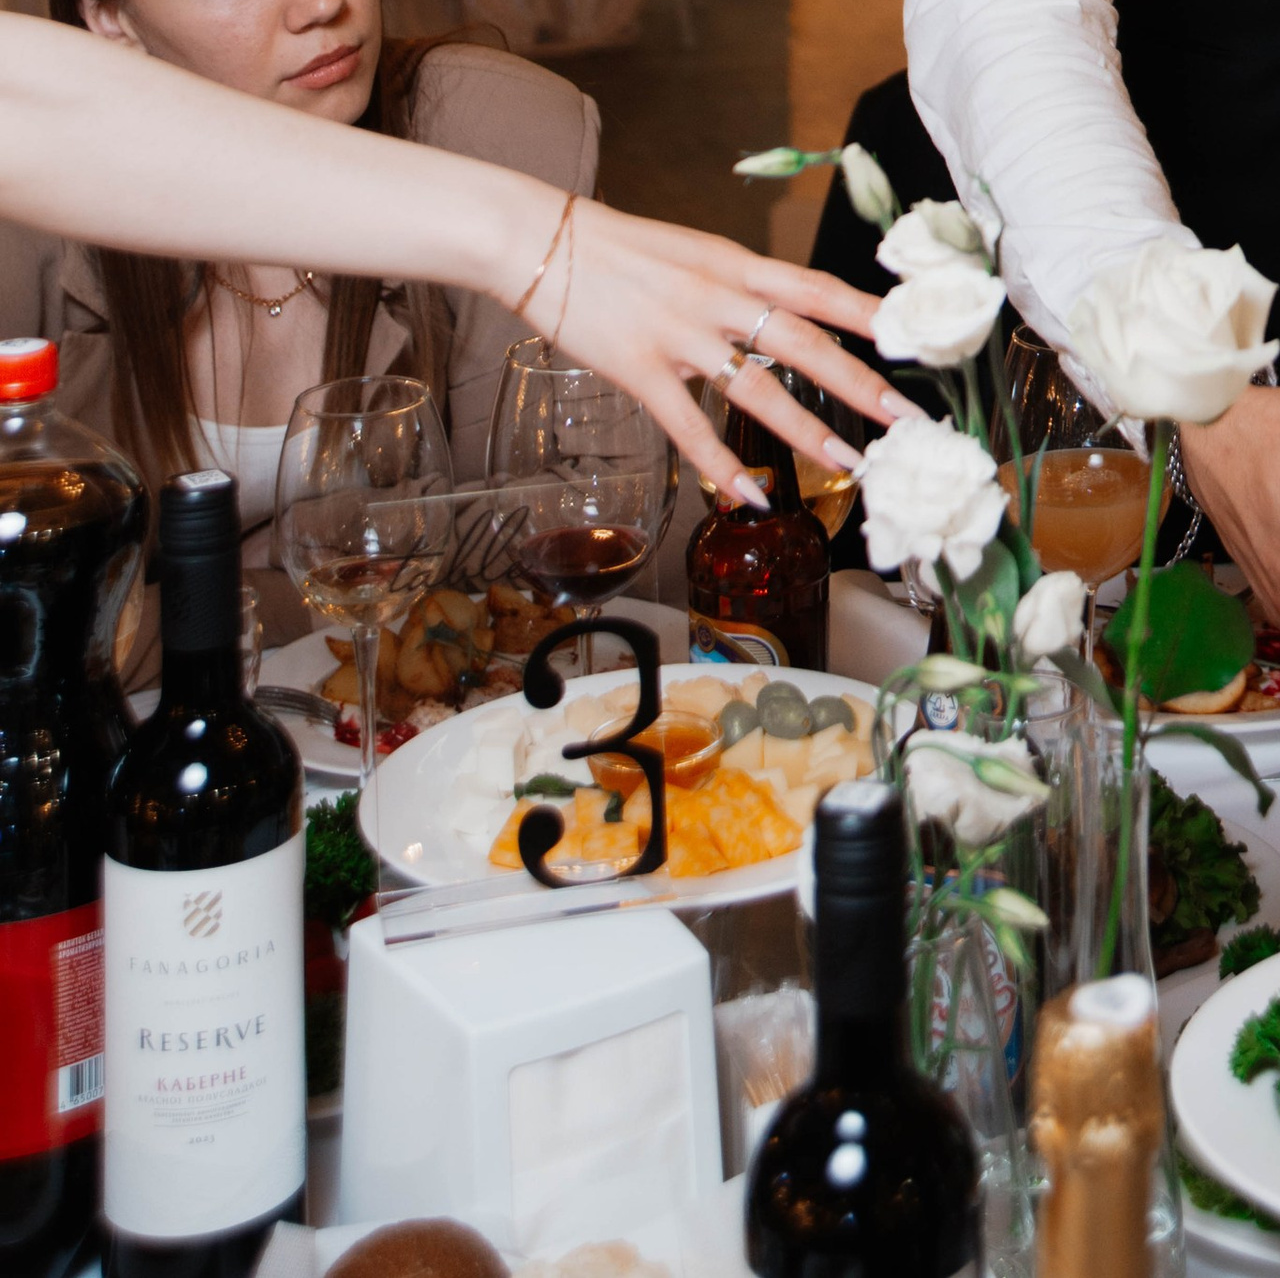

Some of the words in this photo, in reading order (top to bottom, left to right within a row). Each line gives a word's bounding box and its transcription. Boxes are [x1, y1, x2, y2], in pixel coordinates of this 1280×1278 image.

[518, 616, 668, 889] 3
[129, 939, 275, 975] FANAGORIA
[139, 1014, 266, 1052] RESERVE
[156, 1065, 247, 1092] КАБЕРНЕ
